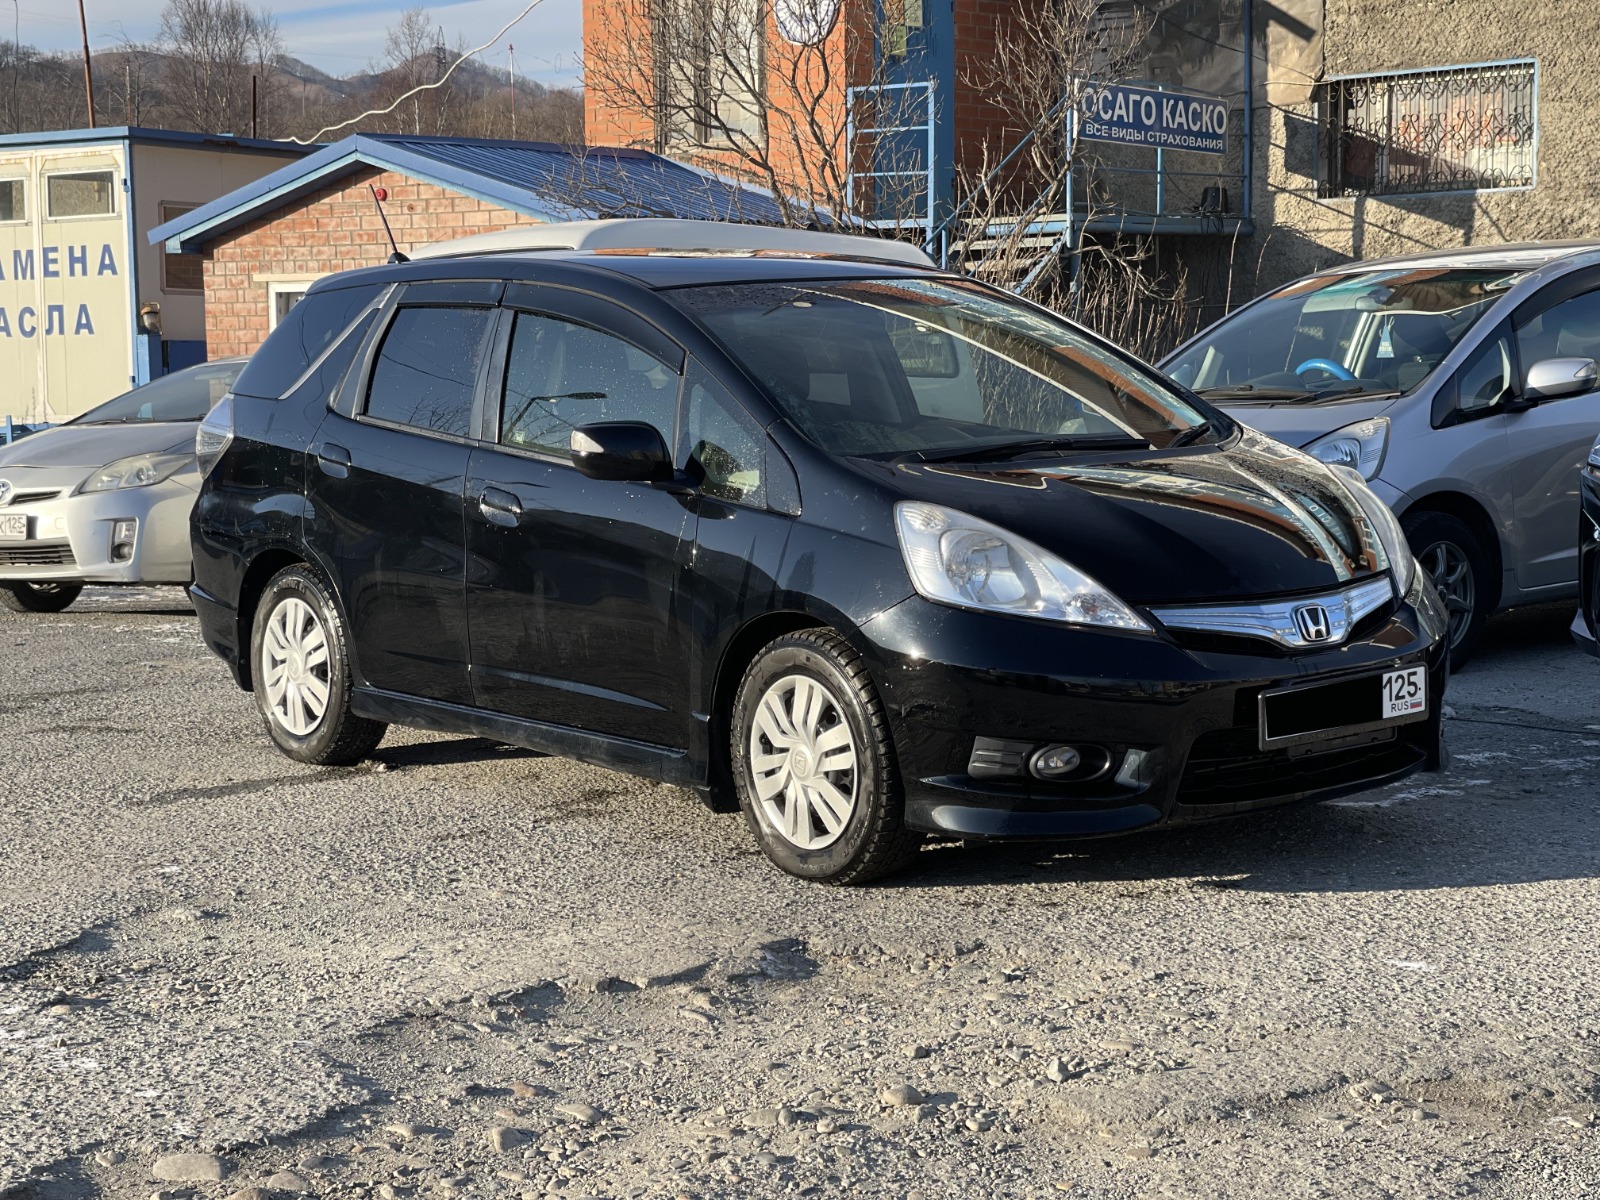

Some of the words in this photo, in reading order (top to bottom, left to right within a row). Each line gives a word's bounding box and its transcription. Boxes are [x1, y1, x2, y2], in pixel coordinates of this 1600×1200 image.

[1081, 87, 1156, 126] ОСАГО
[1162, 98, 1227, 135] КАСКО
[1085, 123, 1109, 137] ВСЕ
[1111, 126, 1145, 142] ВИДЫ
[1147, 131, 1223, 150] СТРАХОВАНИЯ
[0, 243, 118, 281] МЕНА
[1383, 671, 1418, 702] 125
[1390, 700, 1409, 713] RUS
